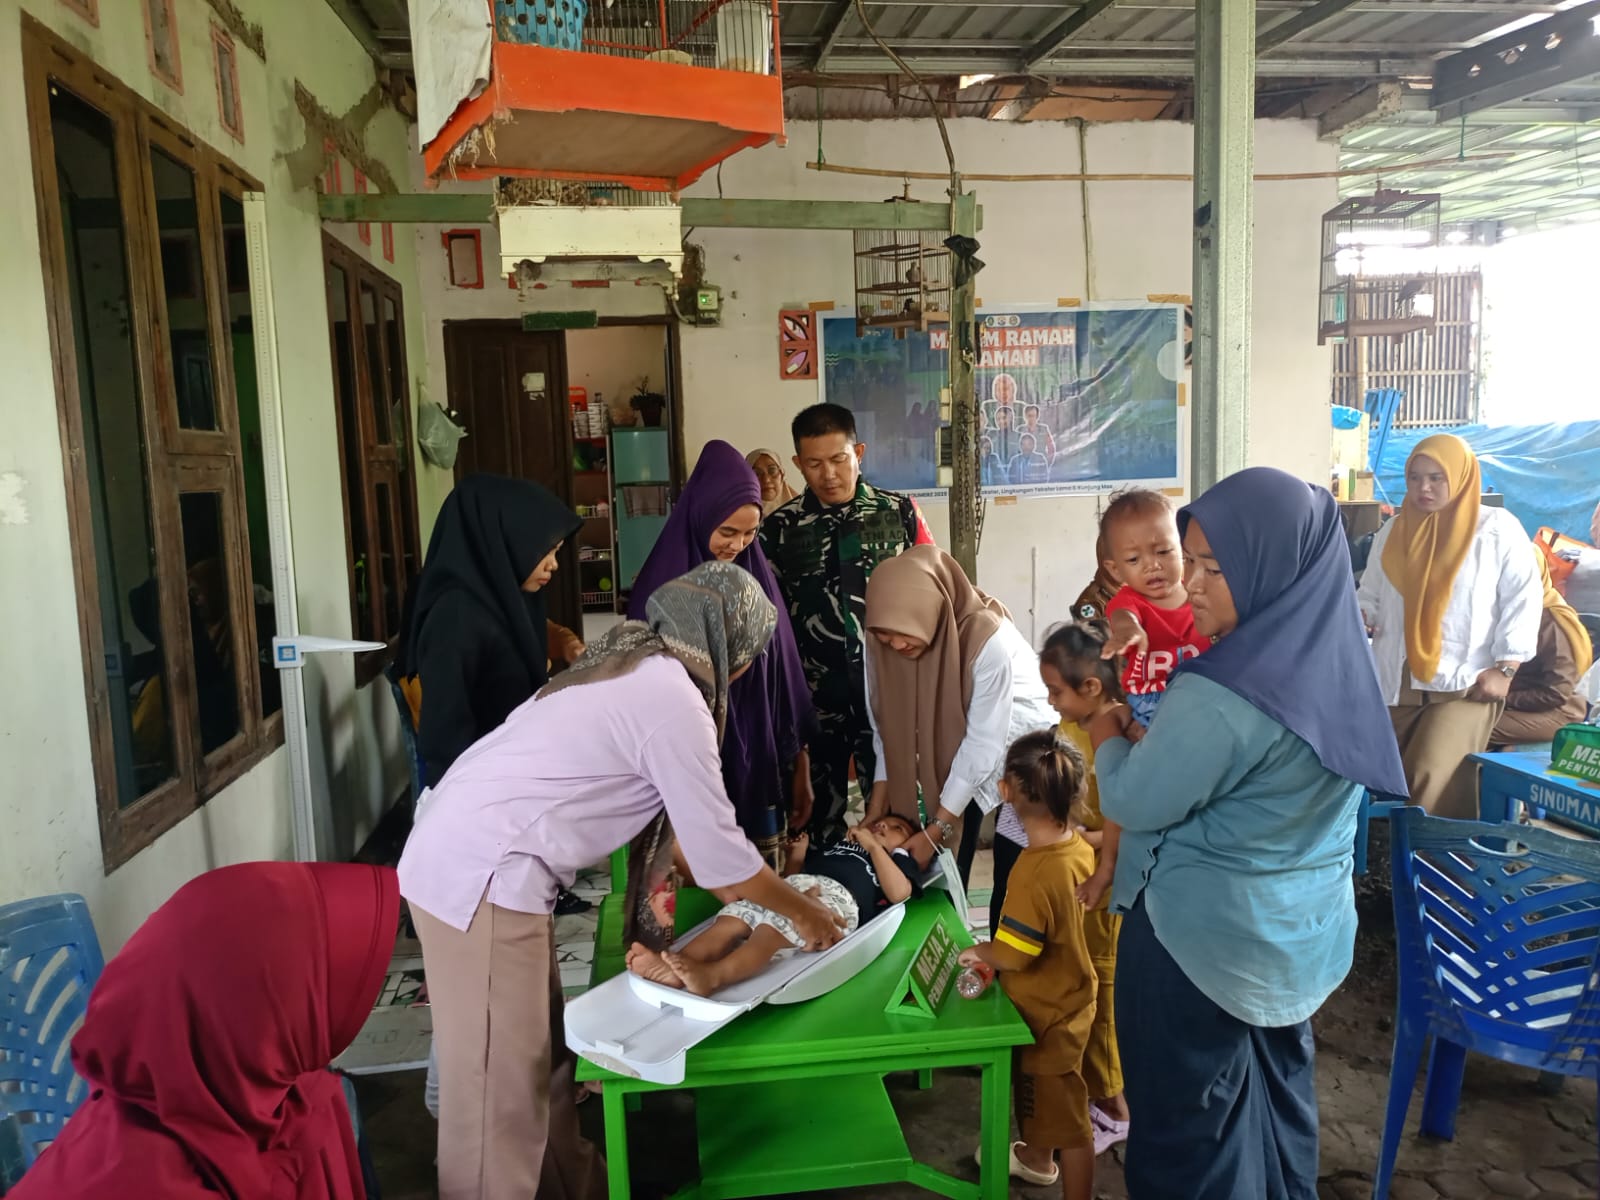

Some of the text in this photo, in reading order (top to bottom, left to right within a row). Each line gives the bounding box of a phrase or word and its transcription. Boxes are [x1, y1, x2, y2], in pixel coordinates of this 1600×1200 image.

[1006, 328, 1075, 347] RAMAH
[975, 349, 1037, 367] AMAH
[1571, 744, 1600, 766] ME
[916, 923, 950, 985] MEJA 2
